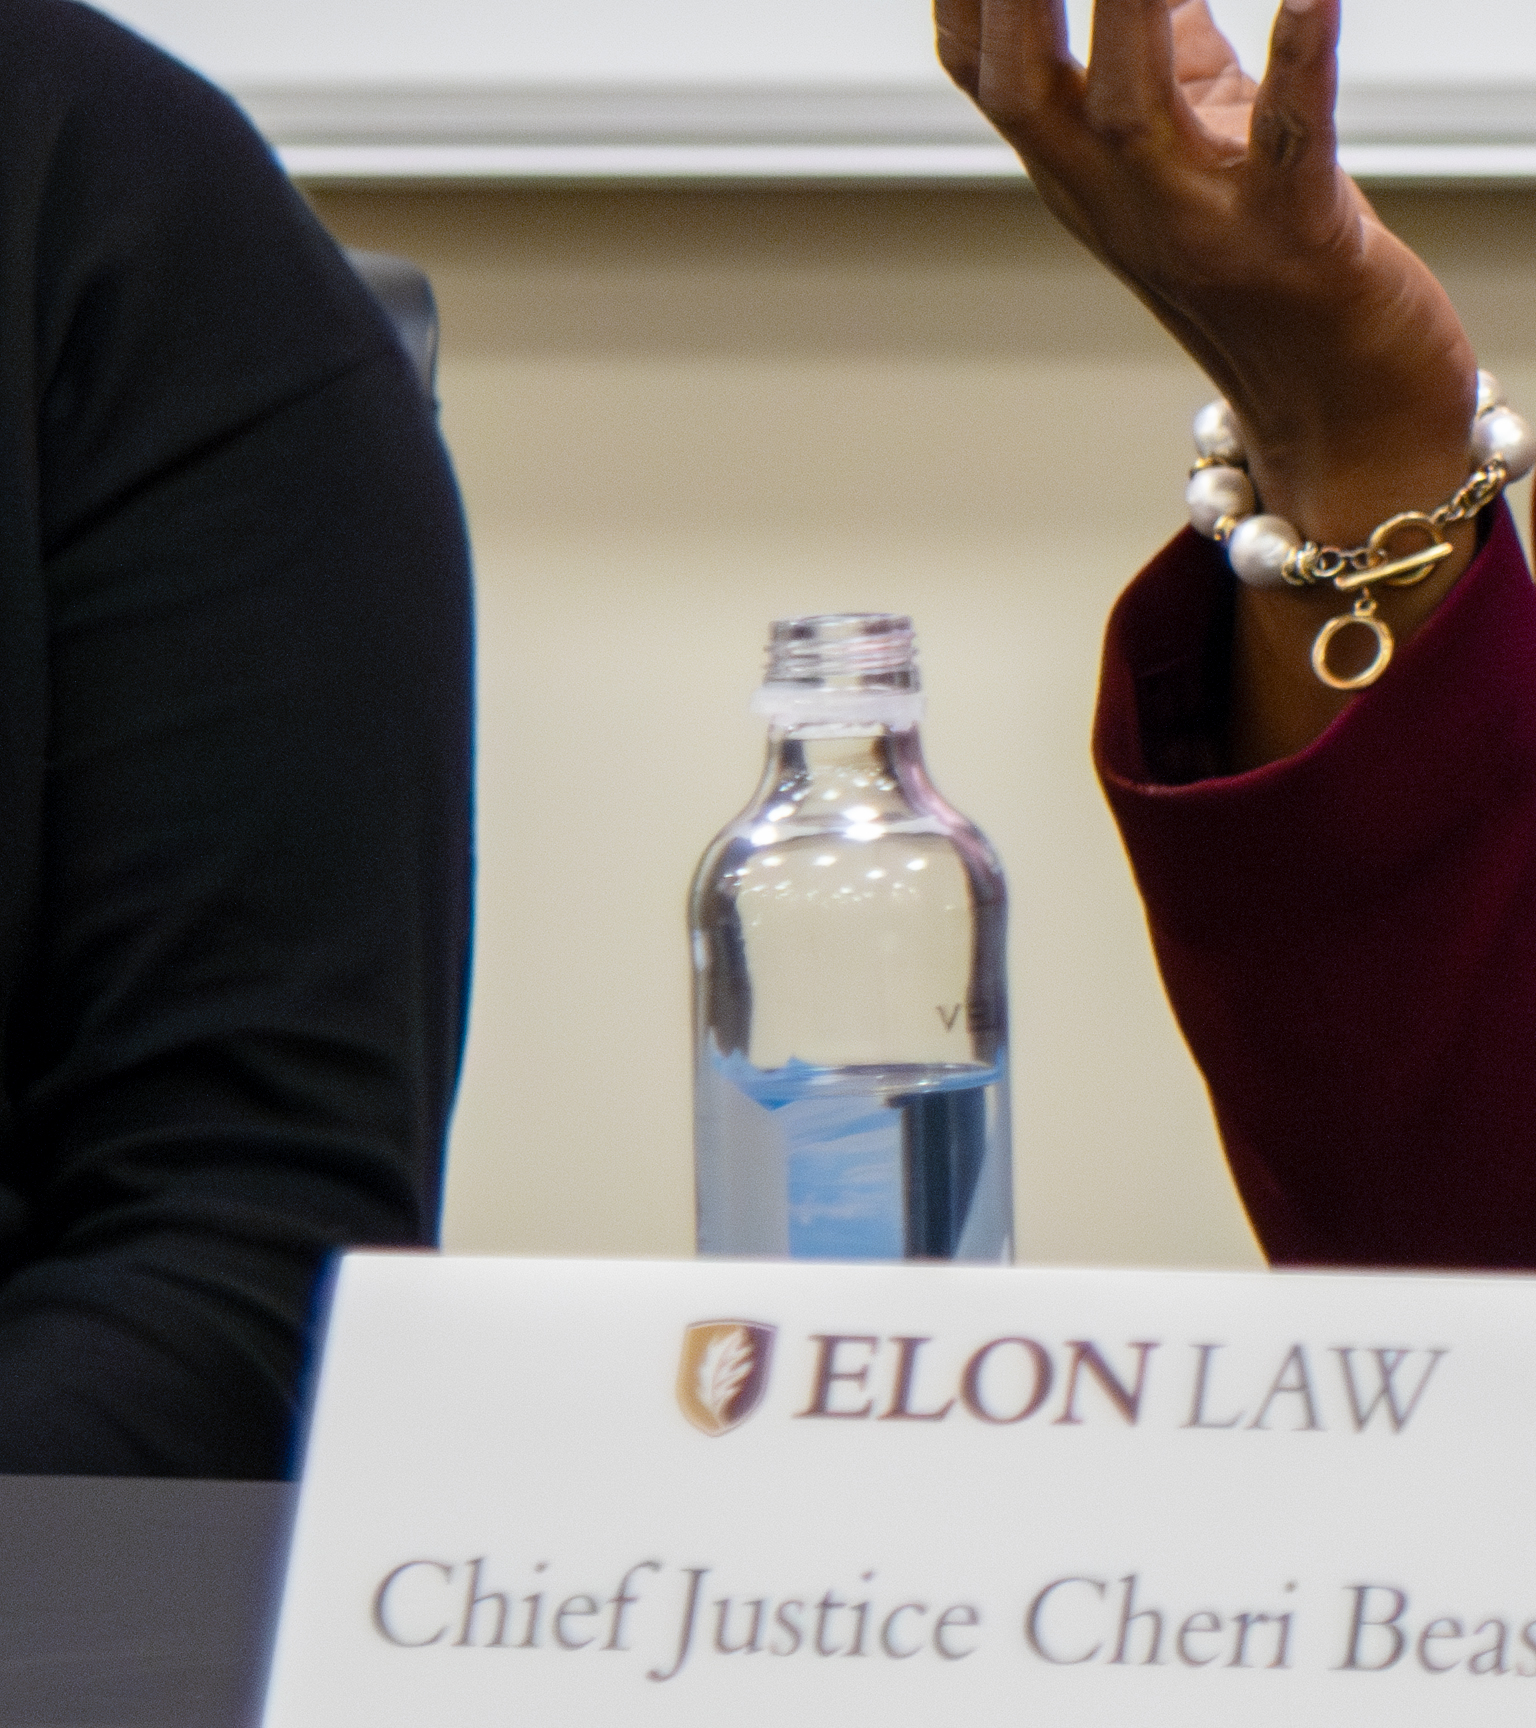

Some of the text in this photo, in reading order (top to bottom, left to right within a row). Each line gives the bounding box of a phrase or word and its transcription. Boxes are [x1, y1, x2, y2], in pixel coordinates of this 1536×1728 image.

[792, 1334, 1450, 1436] ELON LAW
[370, 1556, 663, 1652] Chief
[644, 1567, 982, 1683] Justice
[1022, 1574, 1298, 1670] Cheri
